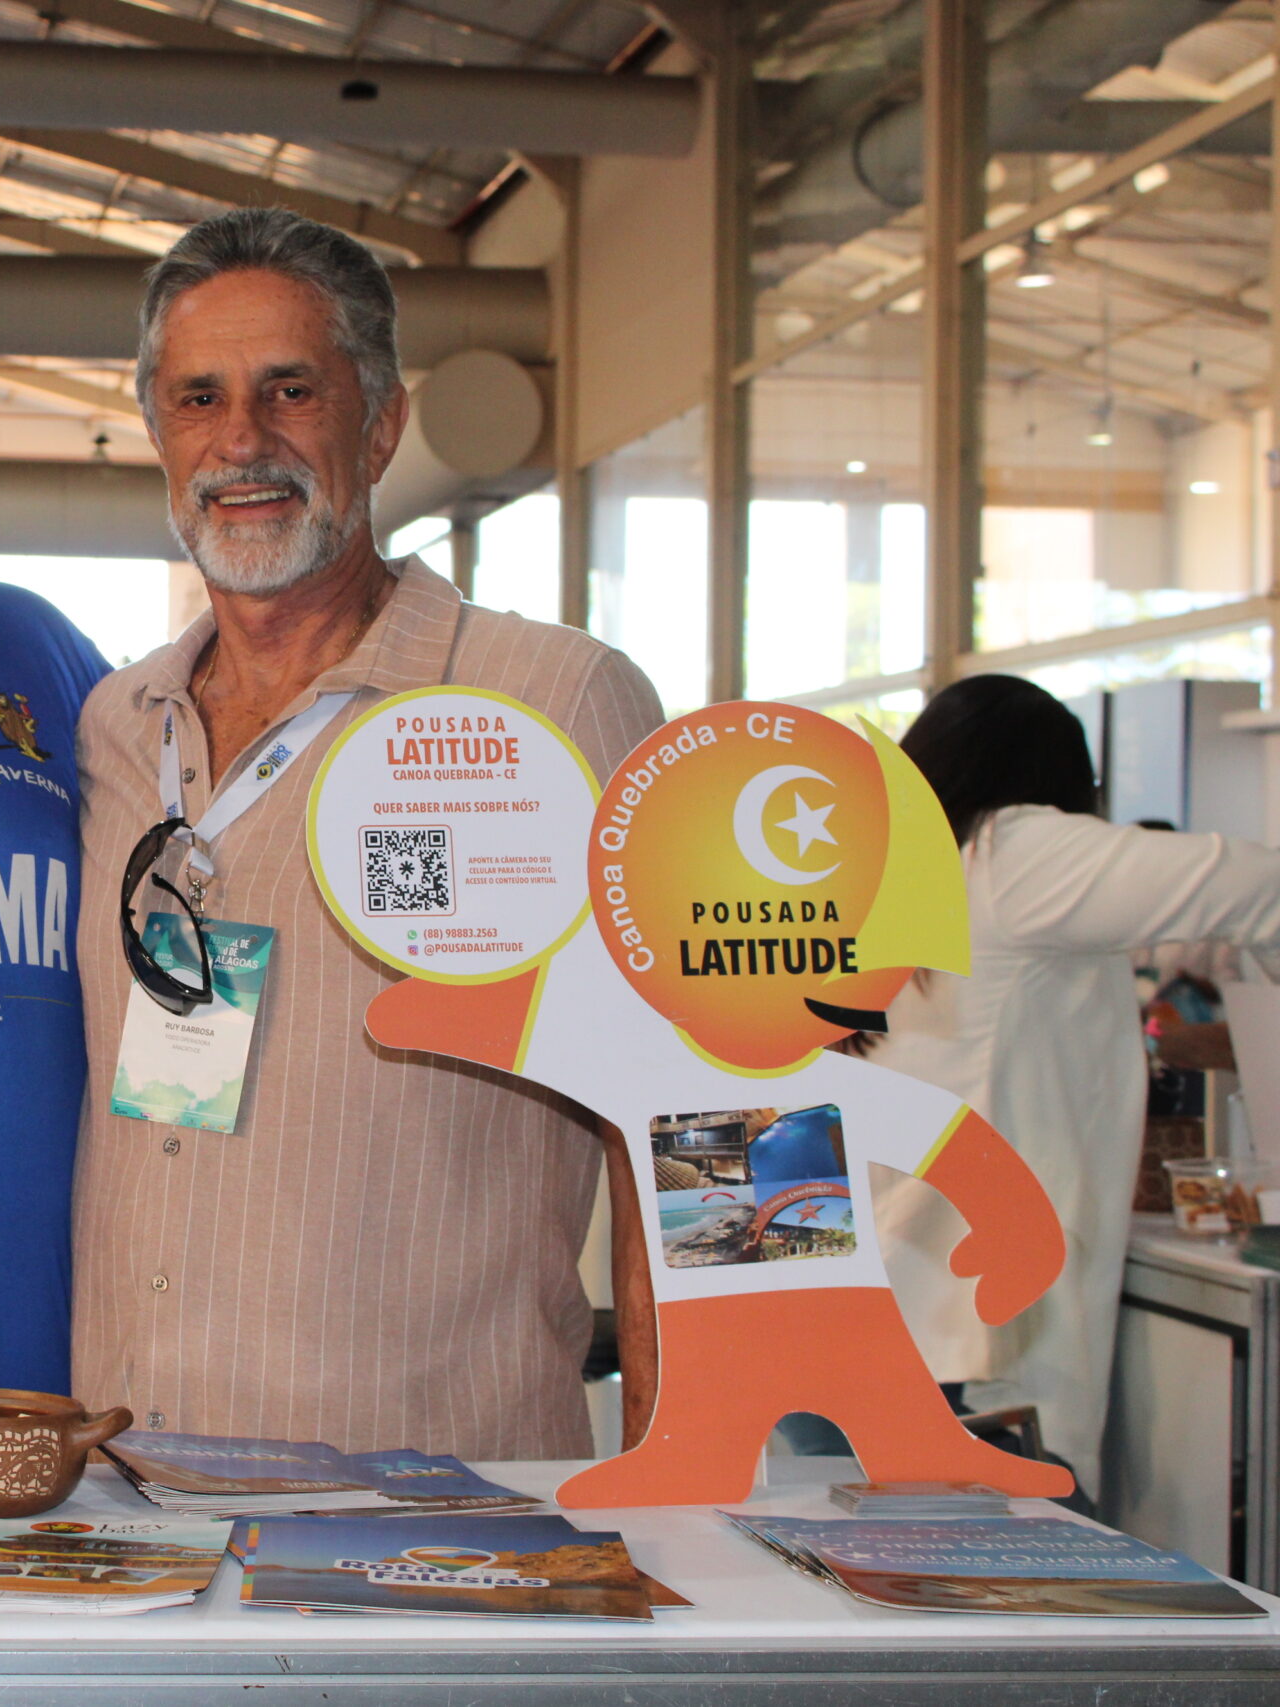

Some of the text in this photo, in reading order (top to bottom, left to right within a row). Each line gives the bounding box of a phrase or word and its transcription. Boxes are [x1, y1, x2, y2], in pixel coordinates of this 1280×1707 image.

[396, 717, 506, 733] POUSADA
[746, 712, 796, 744] CE
[386, 737, 520, 765] LATITUDE
[393, 769, 431, 781] CANOA
[434, 769, 494, 781] QUEBRADA
[504, 769, 517, 780] CE
[599, 724, 718, 852] Quebrada
[373, 798, 540, 815] QUER SABER MAIS SOBRE NÓS?
[603, 865, 655, 974] Canoa
[692, 900, 839, 924] POUSADA
[423, 929, 443, 940] (88)
[424, 942, 524, 956] @POUSADALATITUDE
[215, 955, 259, 970] ALAGOAS
[679, 937, 859, 977] LATITUDE
[181, 1024, 215, 1037] BARBOSA
[880, 1551, 985, 1563] Canoa
[1000, 1552, 1179, 1565] Quebrada
[340, 1559, 438, 1573] Rota
[374, 1571, 543, 1586] Falésias
